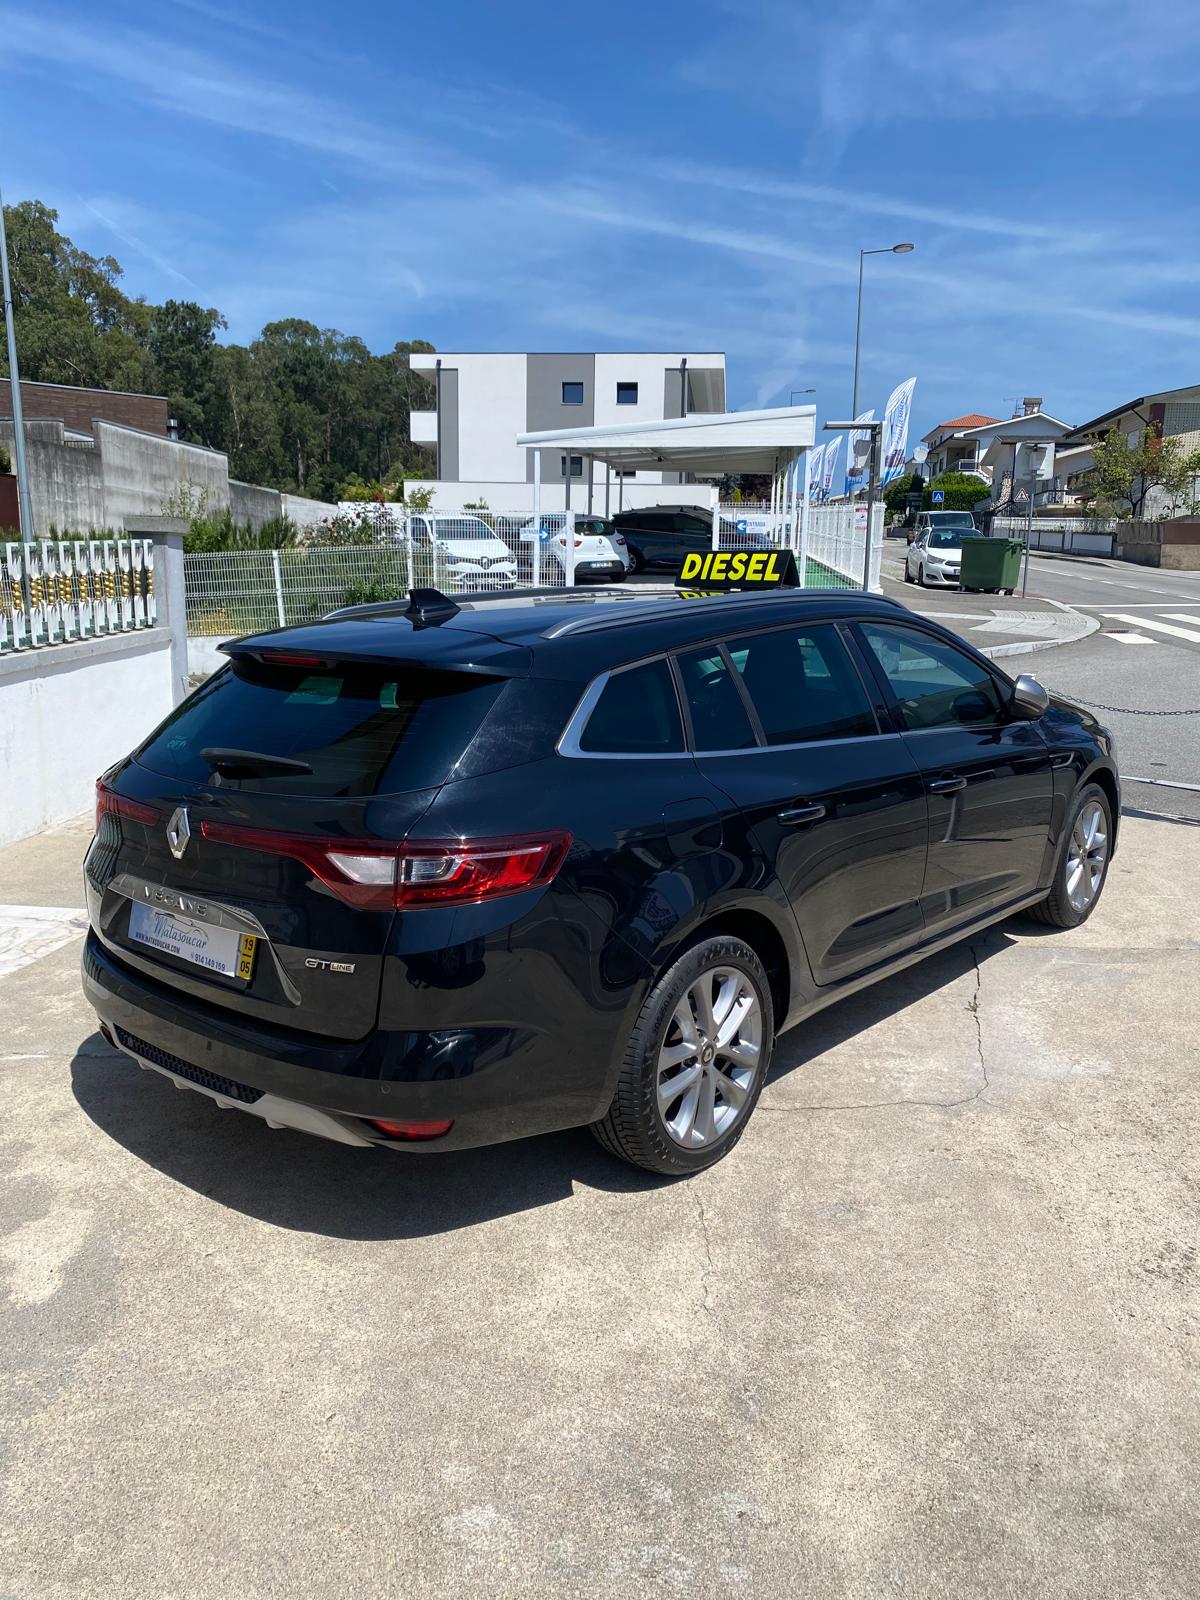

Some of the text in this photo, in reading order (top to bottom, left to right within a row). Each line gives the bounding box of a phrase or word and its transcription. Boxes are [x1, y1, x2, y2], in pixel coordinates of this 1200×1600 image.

[680, 552, 780, 581] DIESEL
[154, 917, 208, 949] Matasoucar
[244, 938, 253, 951] 19
[240, 961, 250, 974] 05
[305, 958, 353, 972] GT LINE
